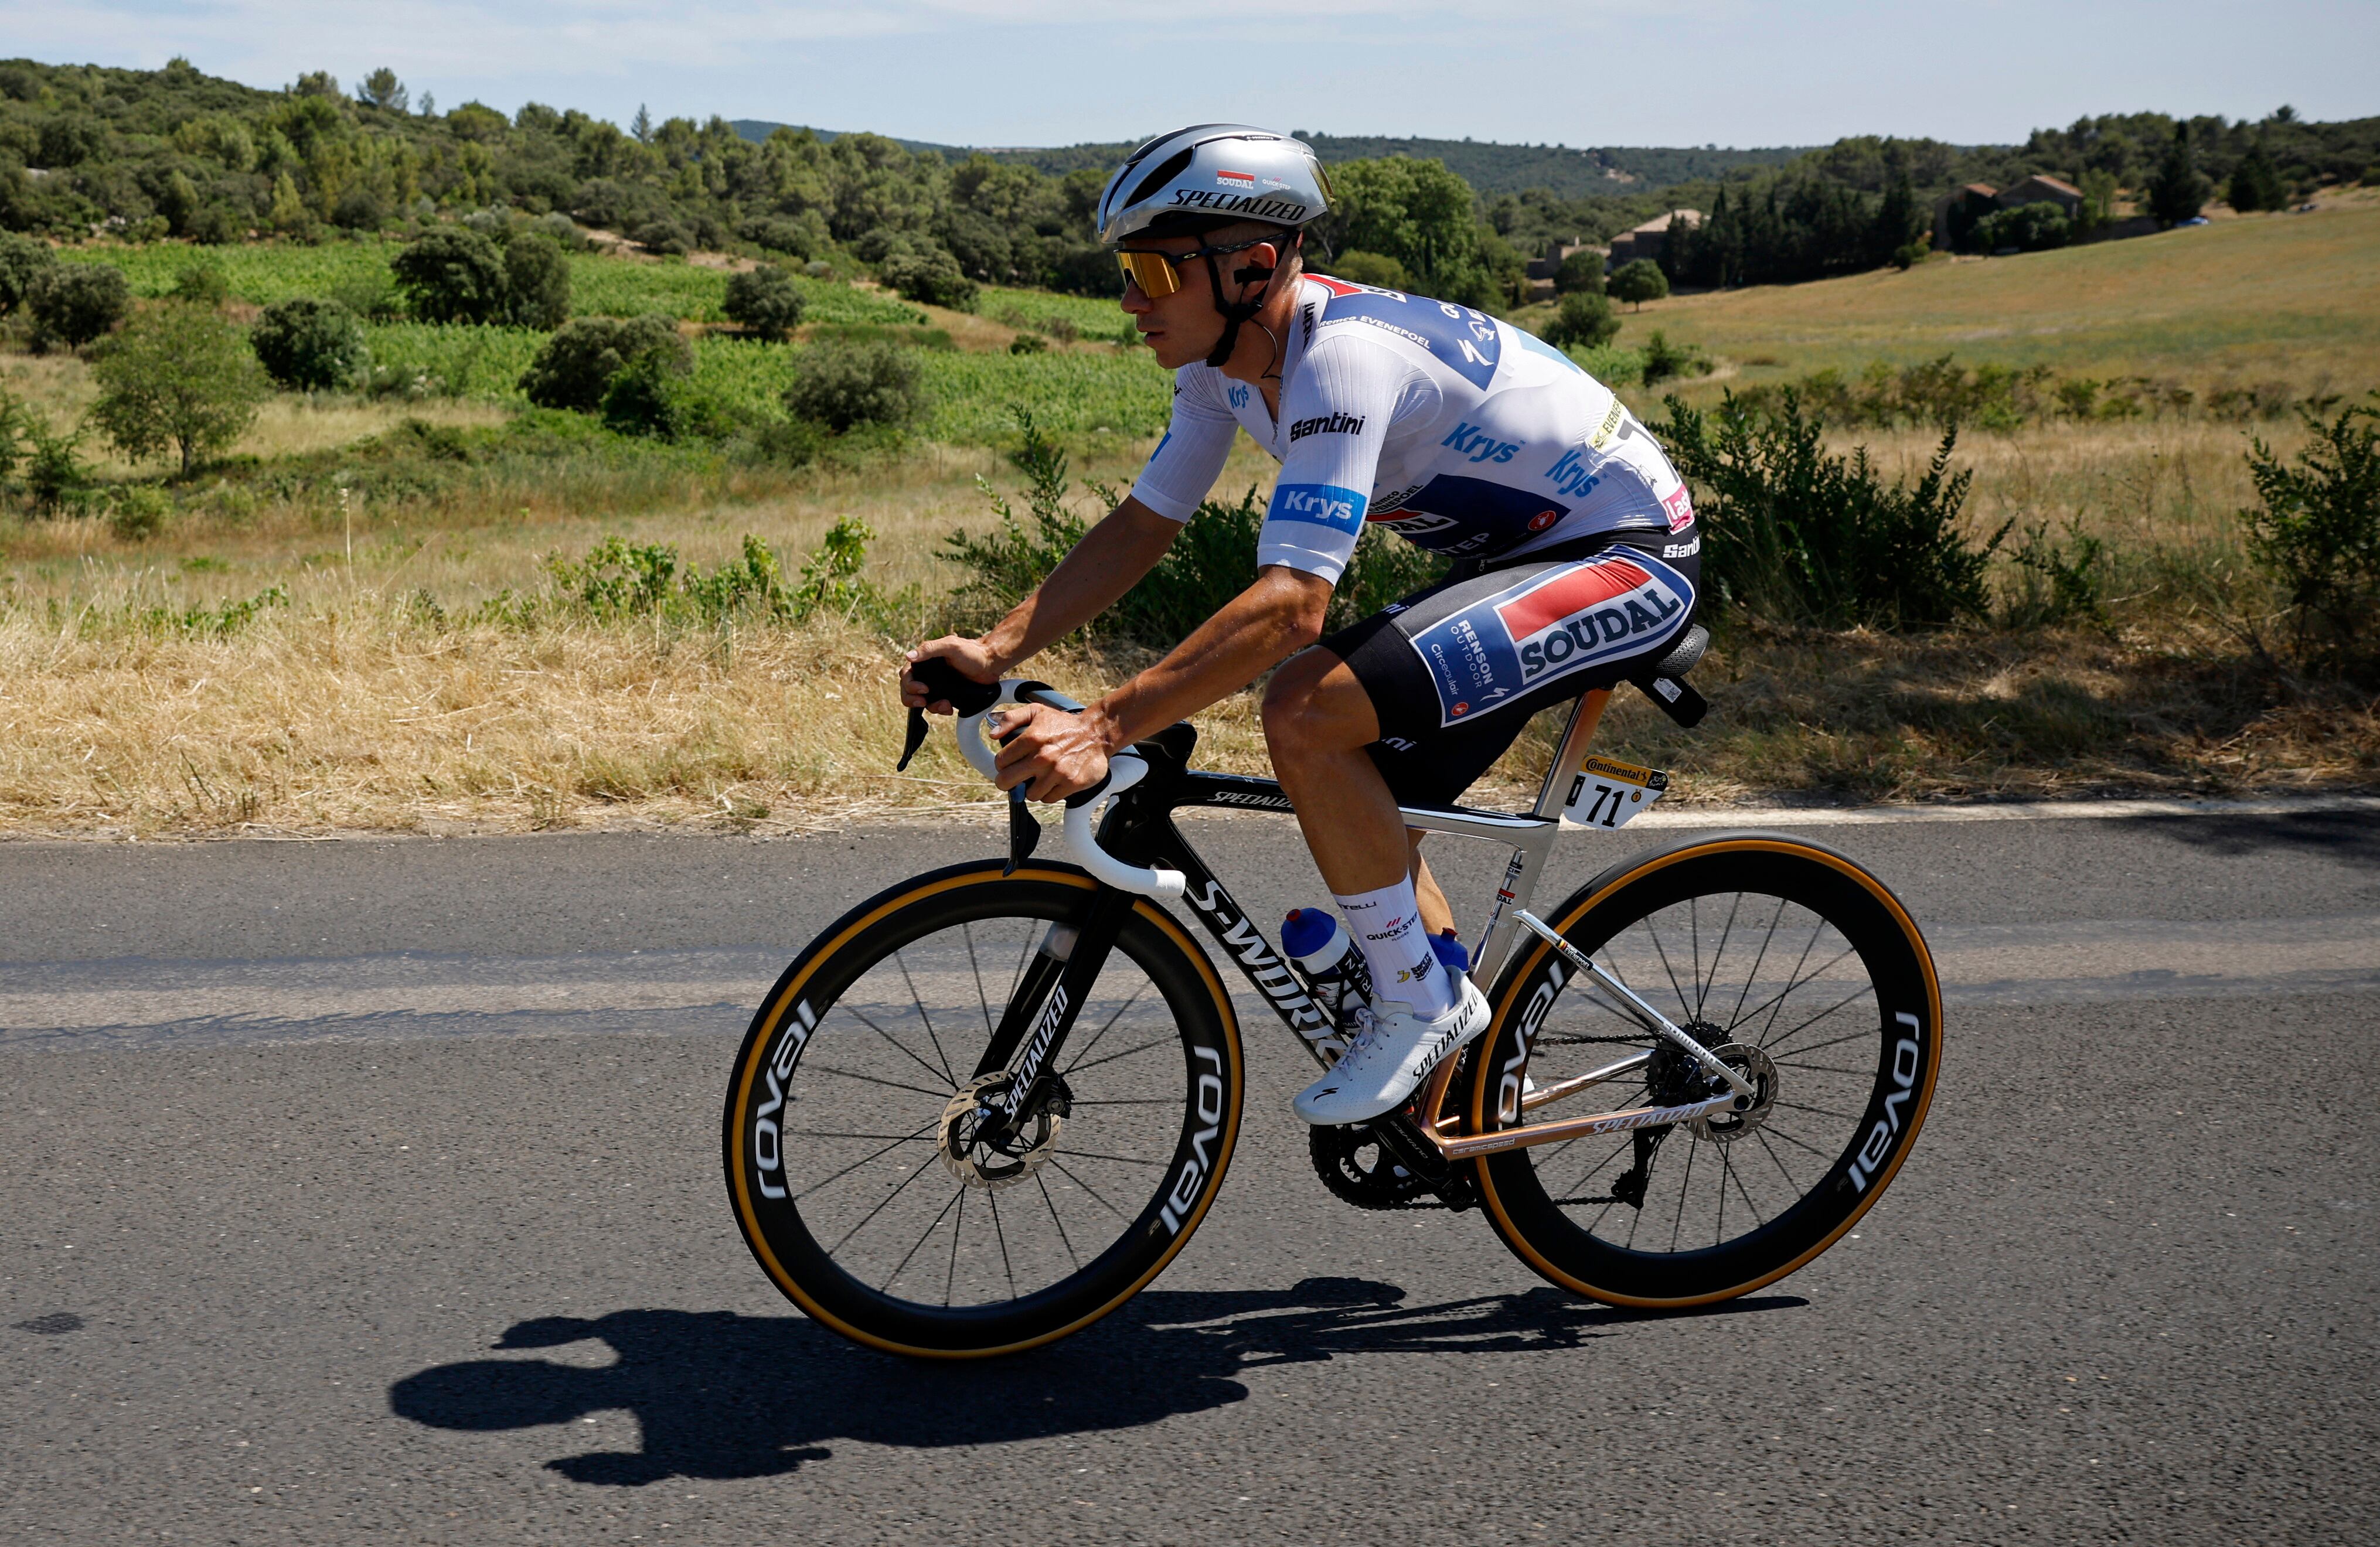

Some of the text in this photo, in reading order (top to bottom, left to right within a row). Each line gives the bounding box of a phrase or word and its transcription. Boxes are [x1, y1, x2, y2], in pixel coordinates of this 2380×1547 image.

[1168, 189, 1307, 222] SPECIALIZED
[1217, 178, 1254, 190] SOUDAL
[1319, 315, 1431, 350] Remco EVENEPOEL
[1228, 384, 1249, 409] Krys
[1291, 412, 1366, 443] Santini
[1441, 422, 1520, 464] Krys
[1544, 449, 1600, 498] Krys
[1285, 490, 1353, 520] Krys
[1458, 619, 1493, 684] RENSON
[1521, 589, 1681, 679] SOUDAL
[1431, 643, 1459, 695] Circeaulair
[1451, 626, 1482, 688] OUTDOOR
[1585, 758, 1641, 781] Continental
[1586, 784, 1625, 827] 71
[1564, 948, 1590, 969] EVENEPOEL
[1004, 985, 1069, 1123] SPECIALIZED
[1413, 987, 1478, 1085] SPECIALIZED
[755, 998, 817, 1199] roval
[1592, 1105, 1707, 1134] SPECIALIZED
[1848, 1011, 1919, 1194] roval
[1160, 1045, 1222, 1236] roval
